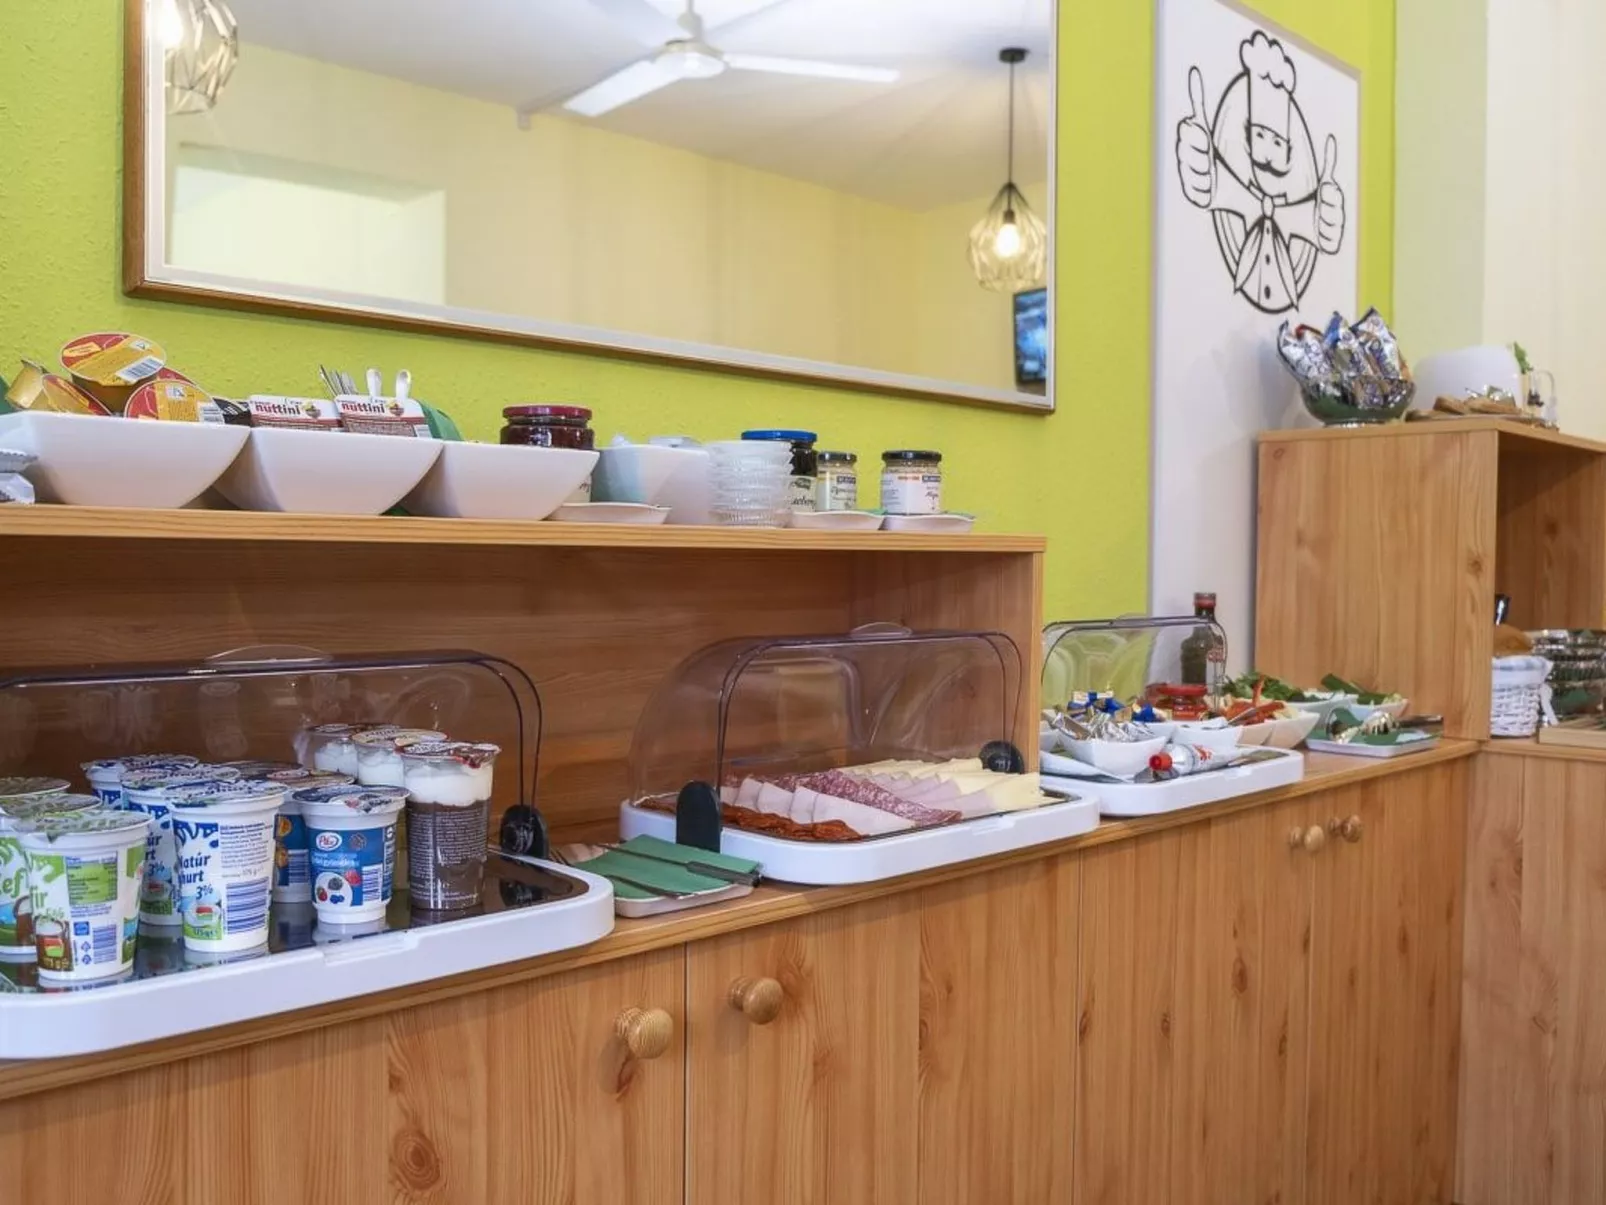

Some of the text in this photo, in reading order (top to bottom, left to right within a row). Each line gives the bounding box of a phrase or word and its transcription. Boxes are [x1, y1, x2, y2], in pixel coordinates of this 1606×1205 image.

[255, 403, 301, 415] nuttini
[341, 402, 386, 414] nuttini
[195, 884, 214, 900] 3%
